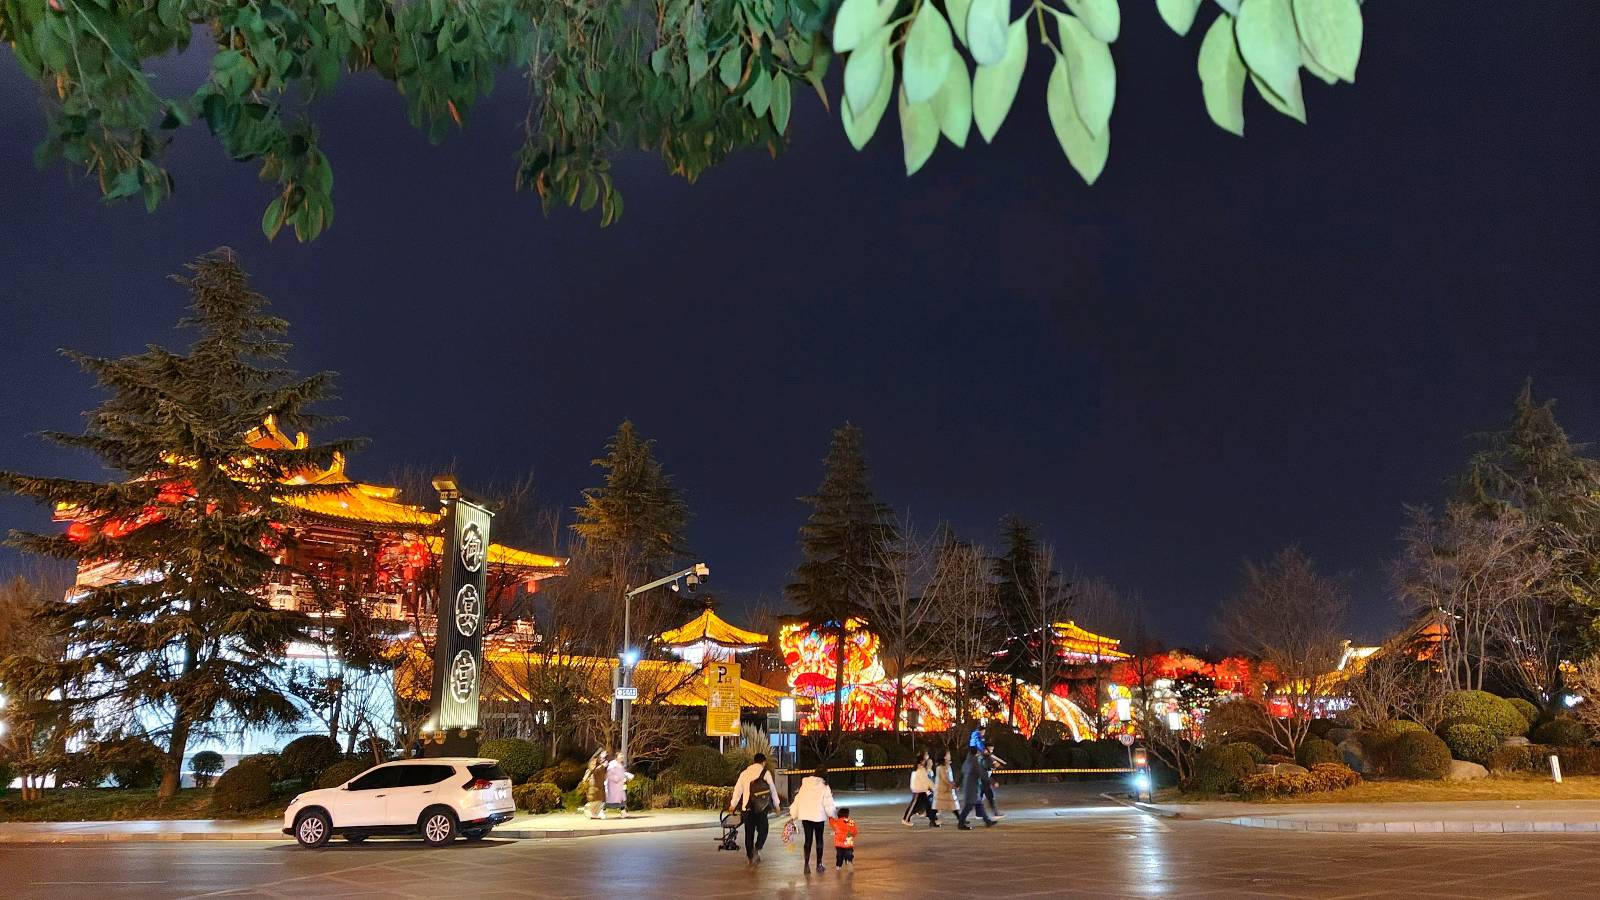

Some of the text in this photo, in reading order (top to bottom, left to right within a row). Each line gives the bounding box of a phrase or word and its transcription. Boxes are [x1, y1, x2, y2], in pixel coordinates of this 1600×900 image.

[455, 528, 483, 697] 御宴宫
[717, 666, 727, 683] P
